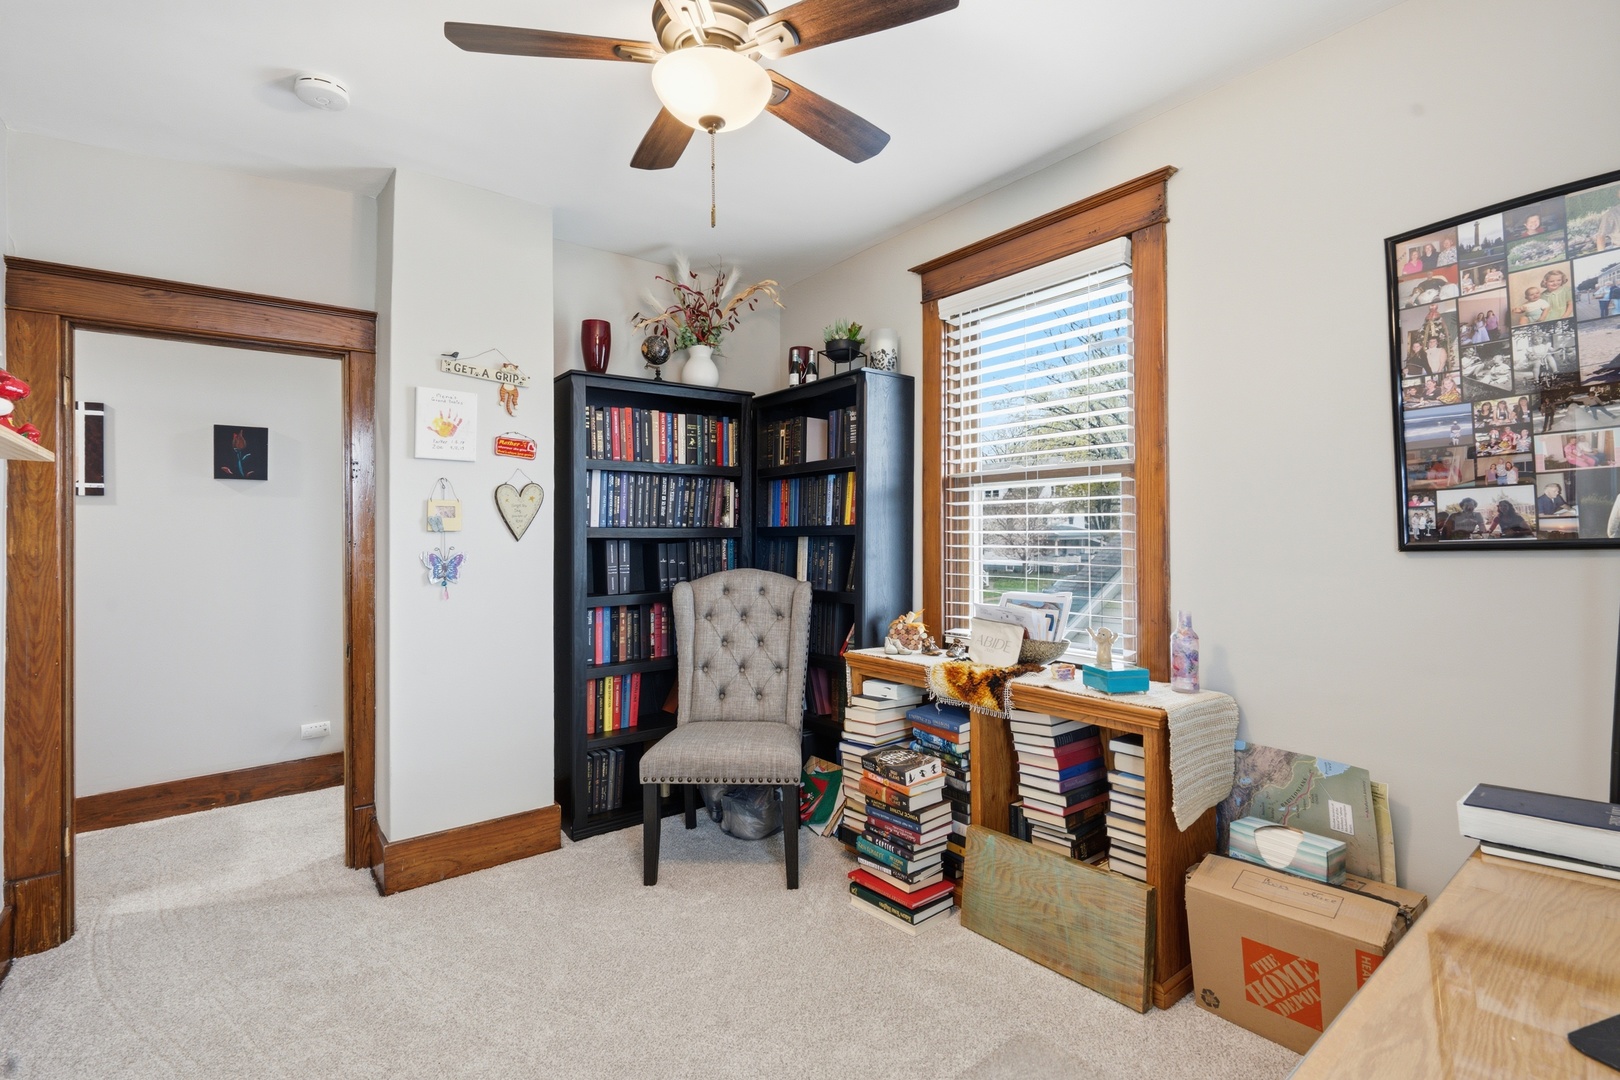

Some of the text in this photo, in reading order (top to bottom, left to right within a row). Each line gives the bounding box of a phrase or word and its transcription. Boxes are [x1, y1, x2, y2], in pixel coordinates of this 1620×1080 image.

[453, 362, 520, 384] GET A GRIP
[975, 634, 1013, 655] ABIDE
[1250, 953, 1281, 975] THE
[1245, 957, 1320, 1007] HOME
[1274, 986, 1322, 1017] DEPOT
